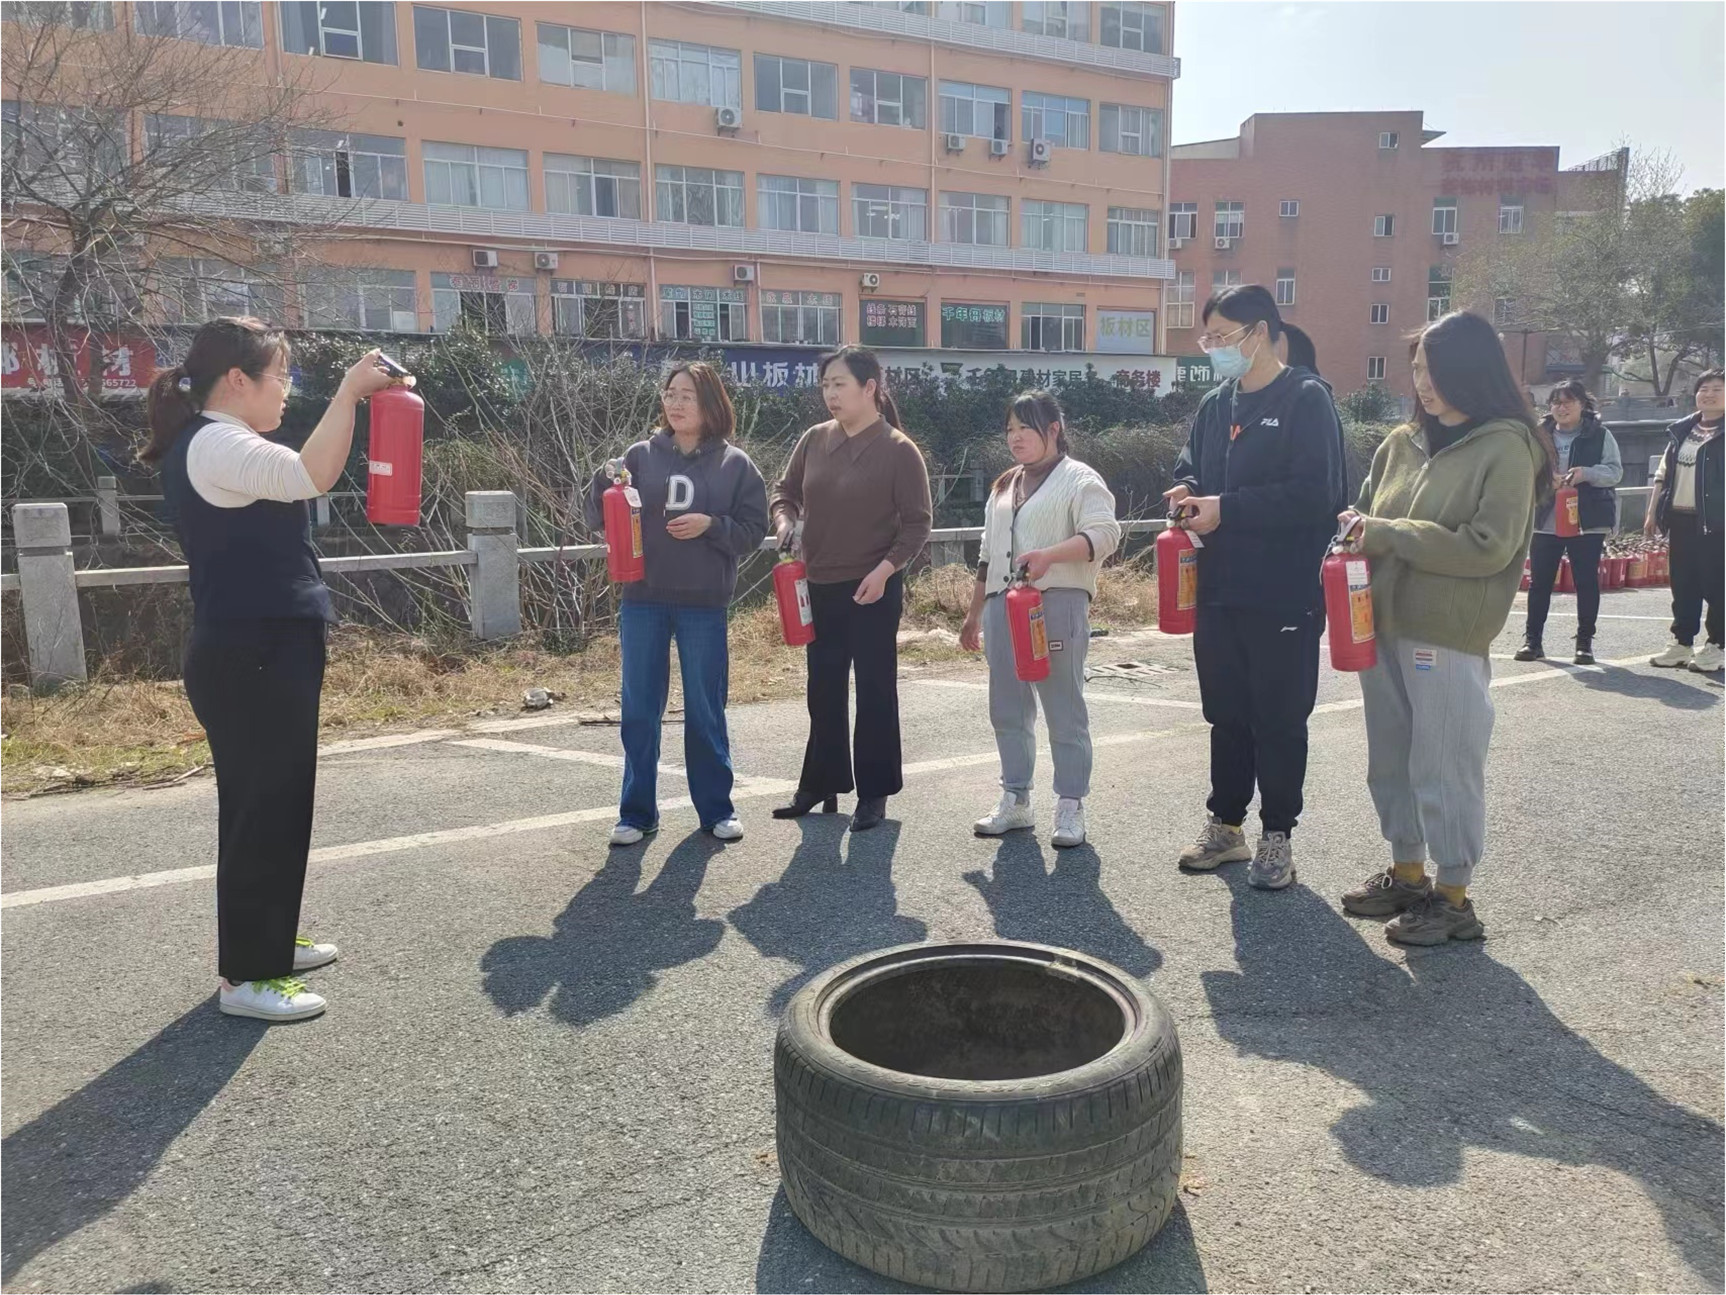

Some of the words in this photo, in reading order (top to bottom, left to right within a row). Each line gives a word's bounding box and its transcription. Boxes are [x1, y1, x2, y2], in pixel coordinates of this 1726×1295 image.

[1101, 316, 1151, 337] 板材区
[665, 474, 695, 510] D
